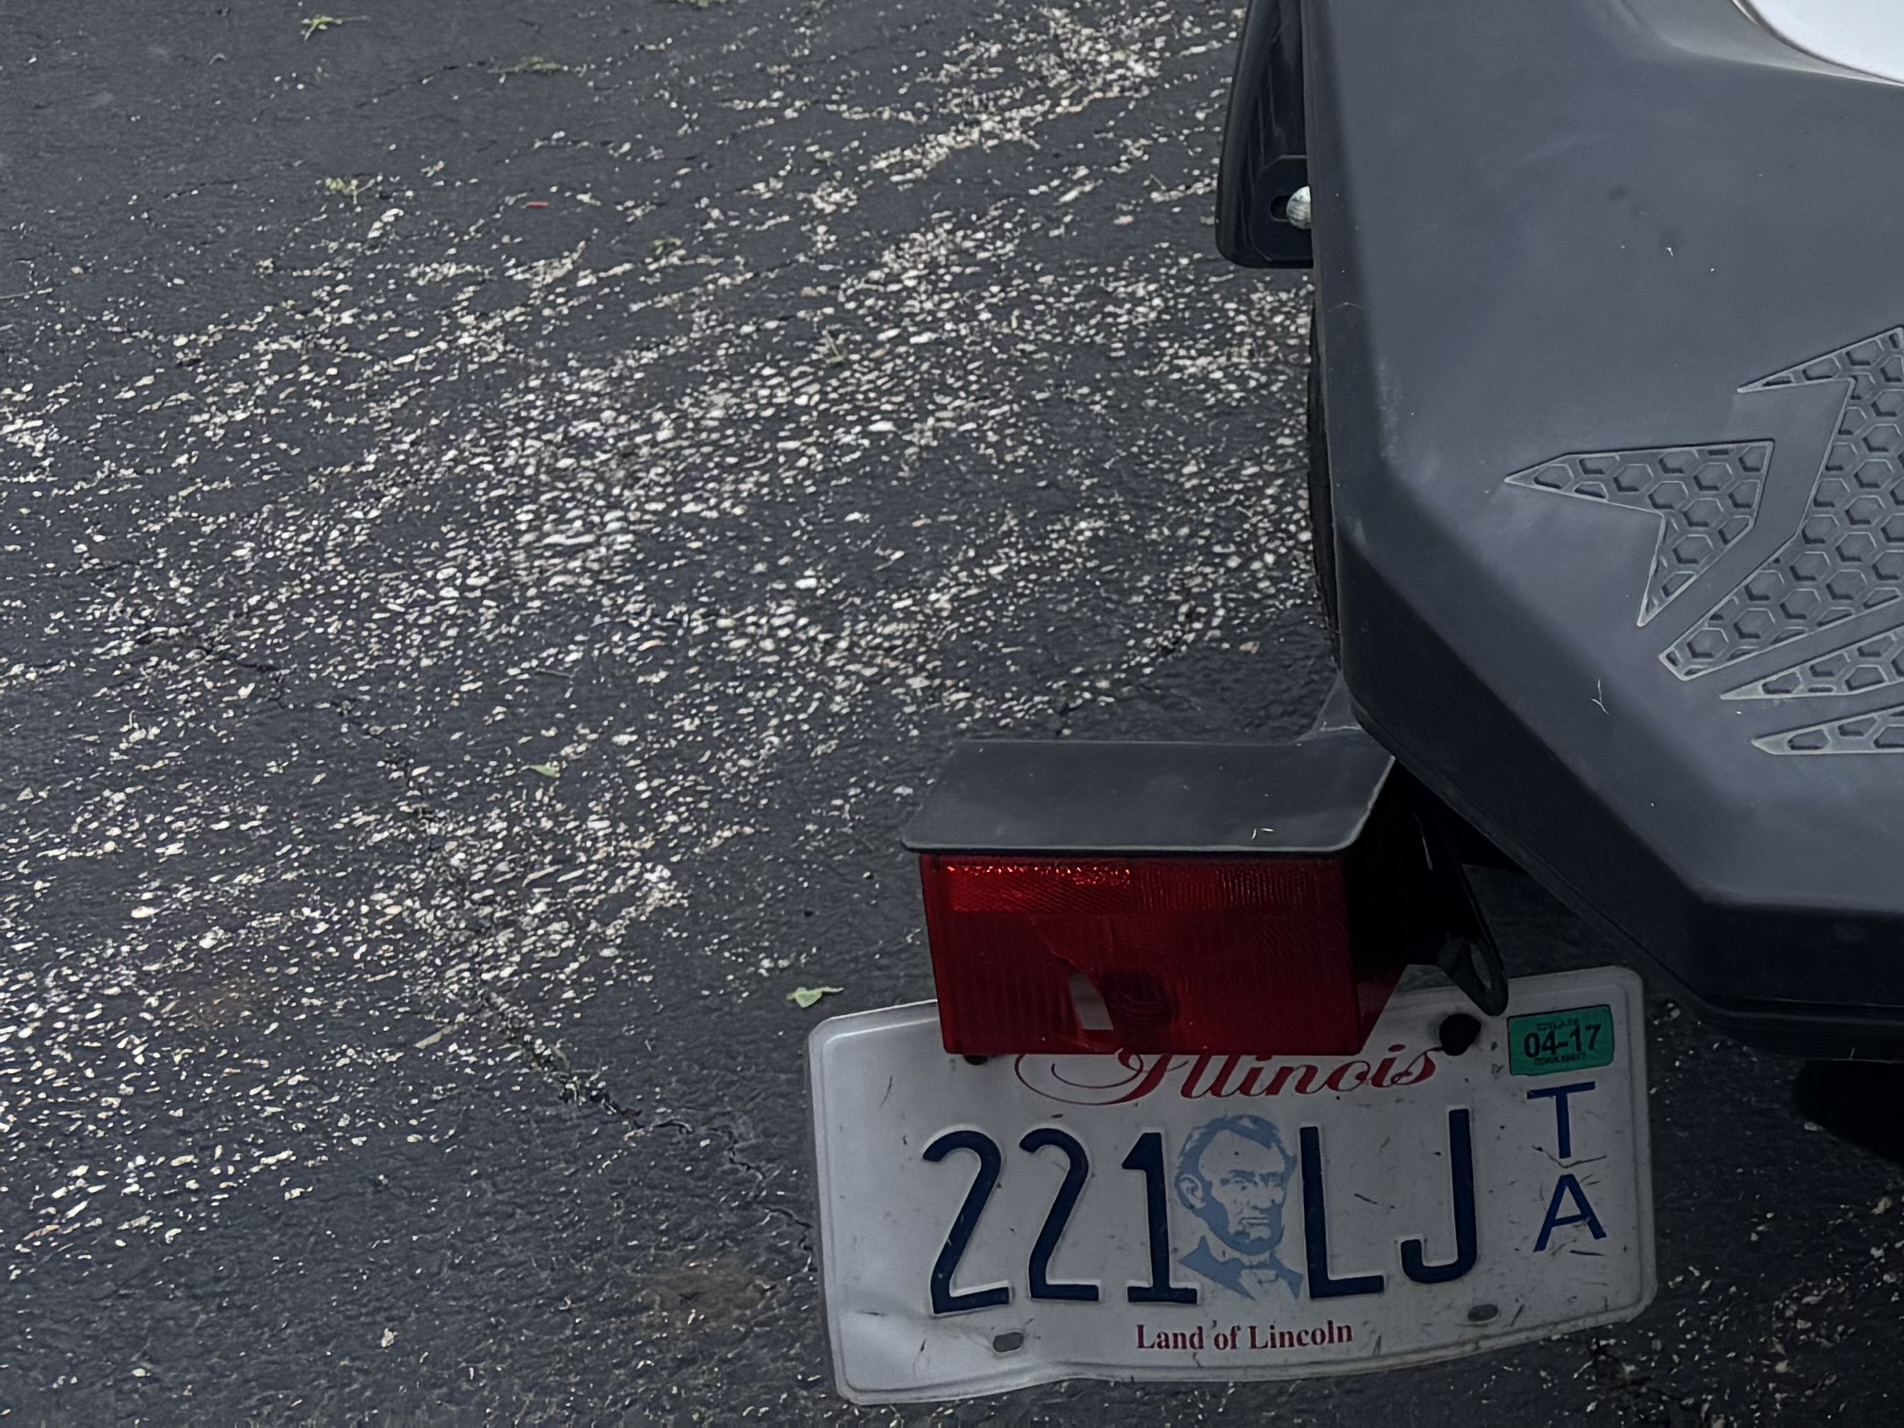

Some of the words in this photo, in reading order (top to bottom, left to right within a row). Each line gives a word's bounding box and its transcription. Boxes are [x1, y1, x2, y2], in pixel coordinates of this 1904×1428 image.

[1524, 1024, 1602, 1059] 04-17
[1014, 1043, 1441, 1106] Illinois
[922, 1127, 1199, 1316] 221
[1298, 1107, 1480, 1300] LJ
[1135, 1323, 1206, 1351] Land
[1213, 1322, 1241, 1351] of
[1247, 1319, 1354, 1351] Lincoln
